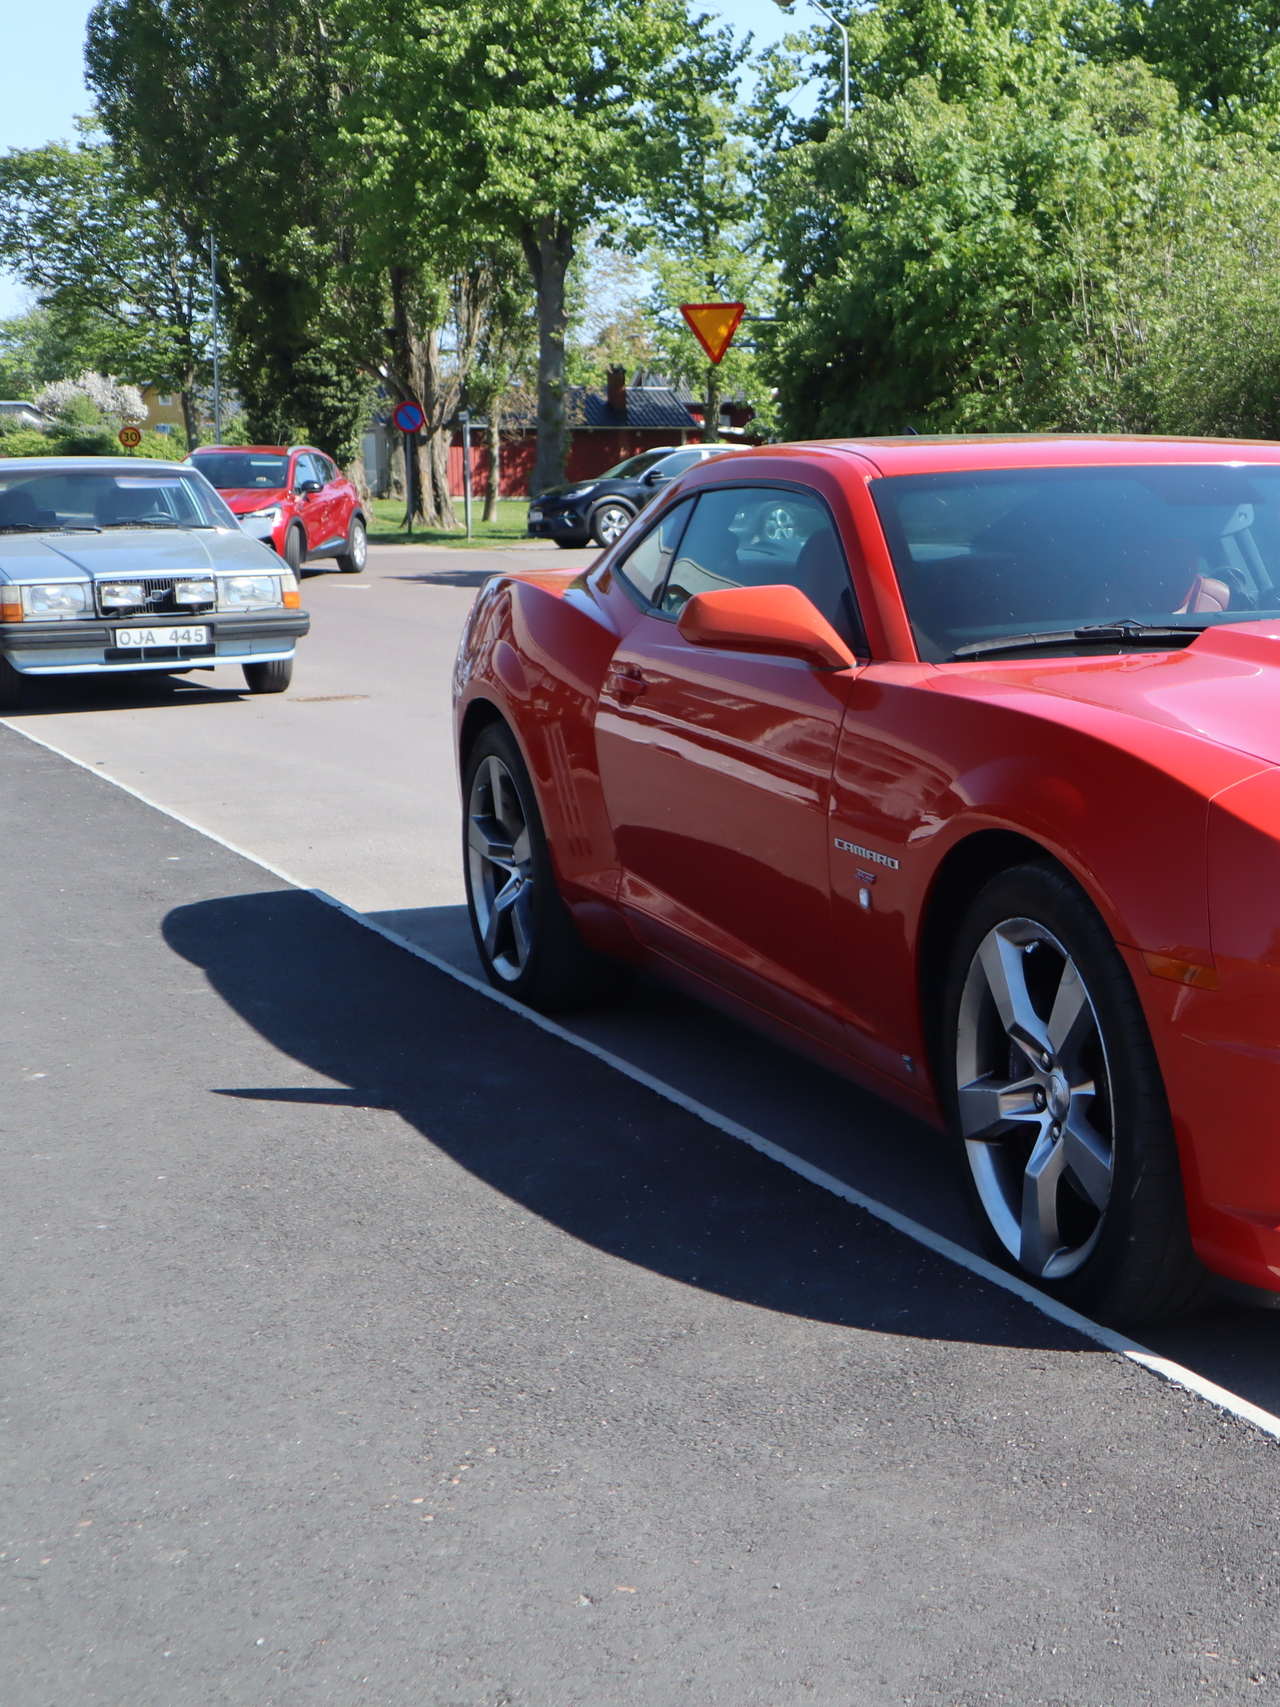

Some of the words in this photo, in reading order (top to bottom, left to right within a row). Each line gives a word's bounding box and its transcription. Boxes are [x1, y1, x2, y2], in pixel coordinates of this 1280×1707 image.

[123, 432, 138, 442] 30
[119, 630, 156, 646] OJA
[169, 628, 204, 643] 445
[834, 837, 899, 870] CAMARO
